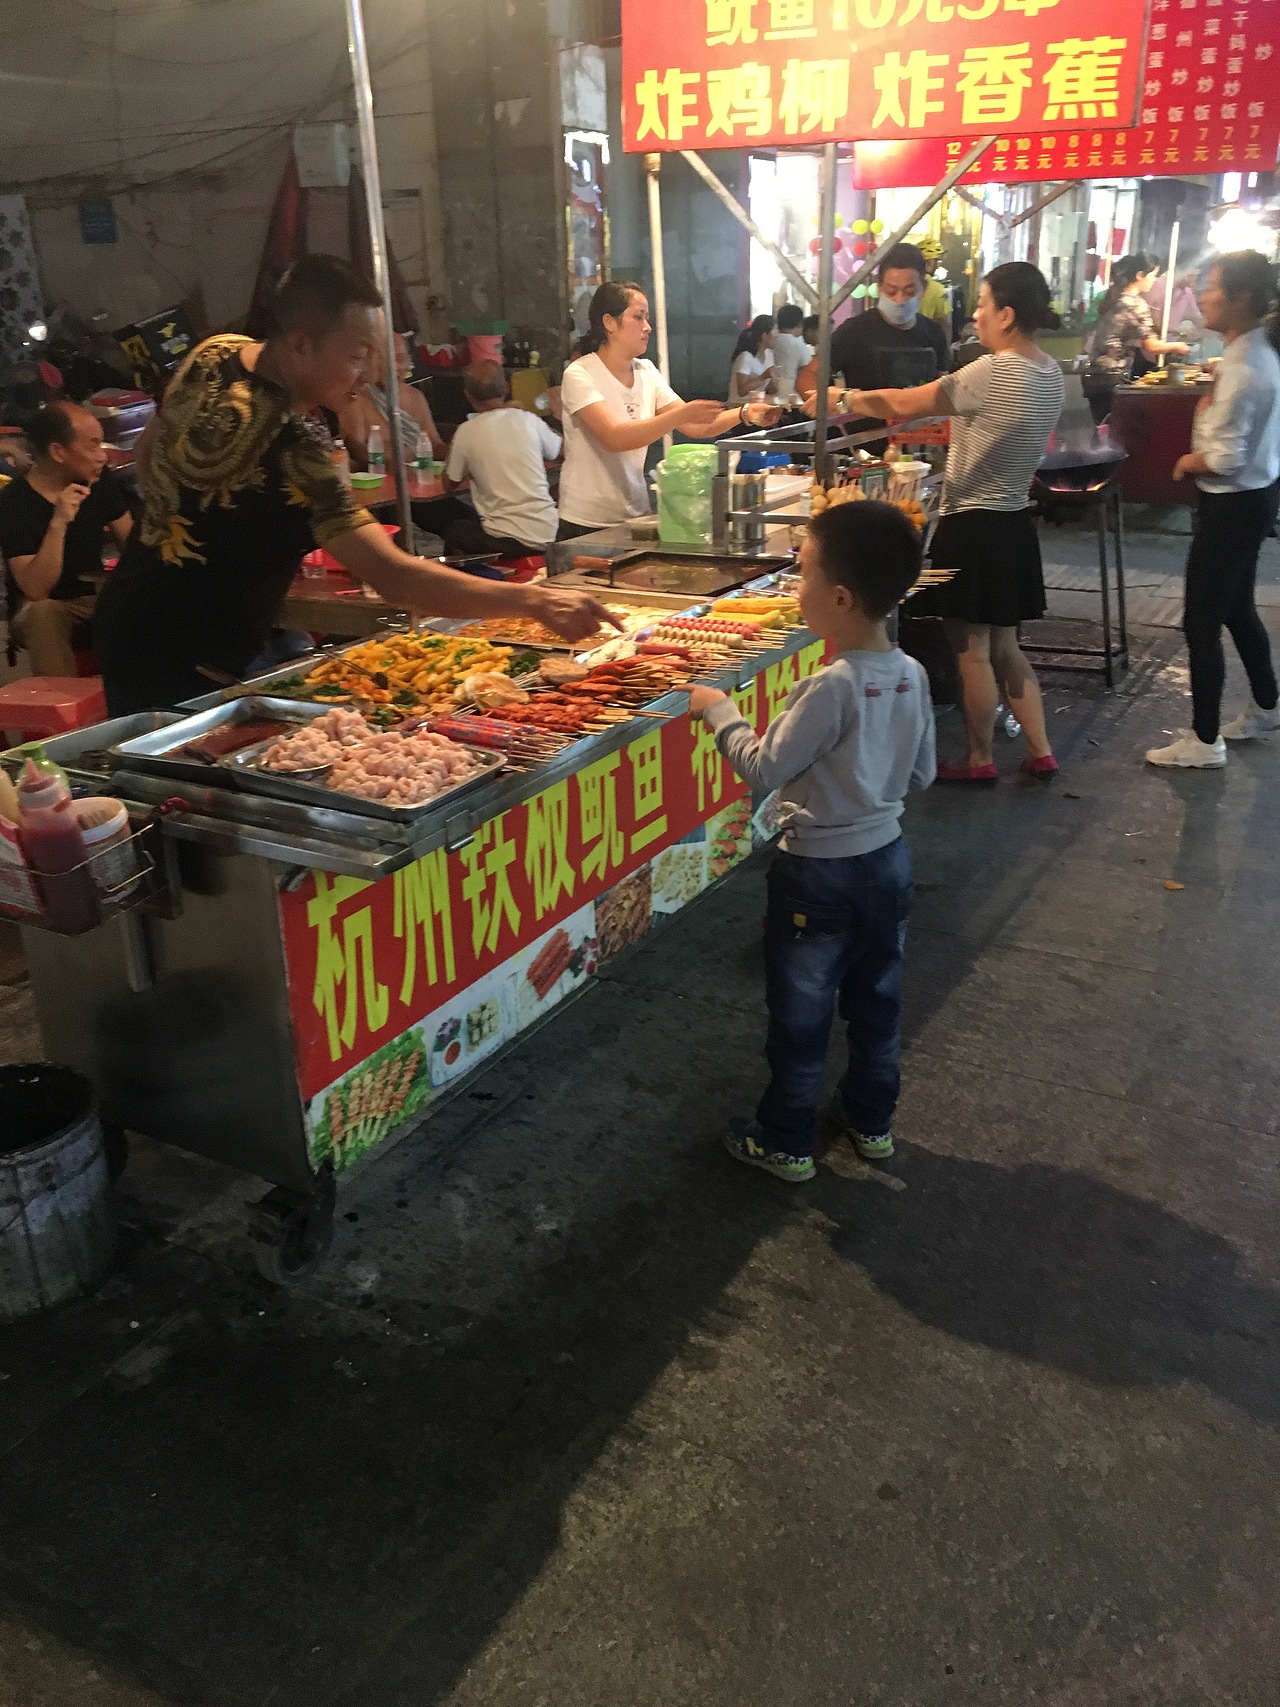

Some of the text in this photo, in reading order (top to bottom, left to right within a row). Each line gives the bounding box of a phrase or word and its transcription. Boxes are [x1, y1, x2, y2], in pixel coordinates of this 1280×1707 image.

[636, 37, 1128, 141] 炸鸡柳 炸香蕉
